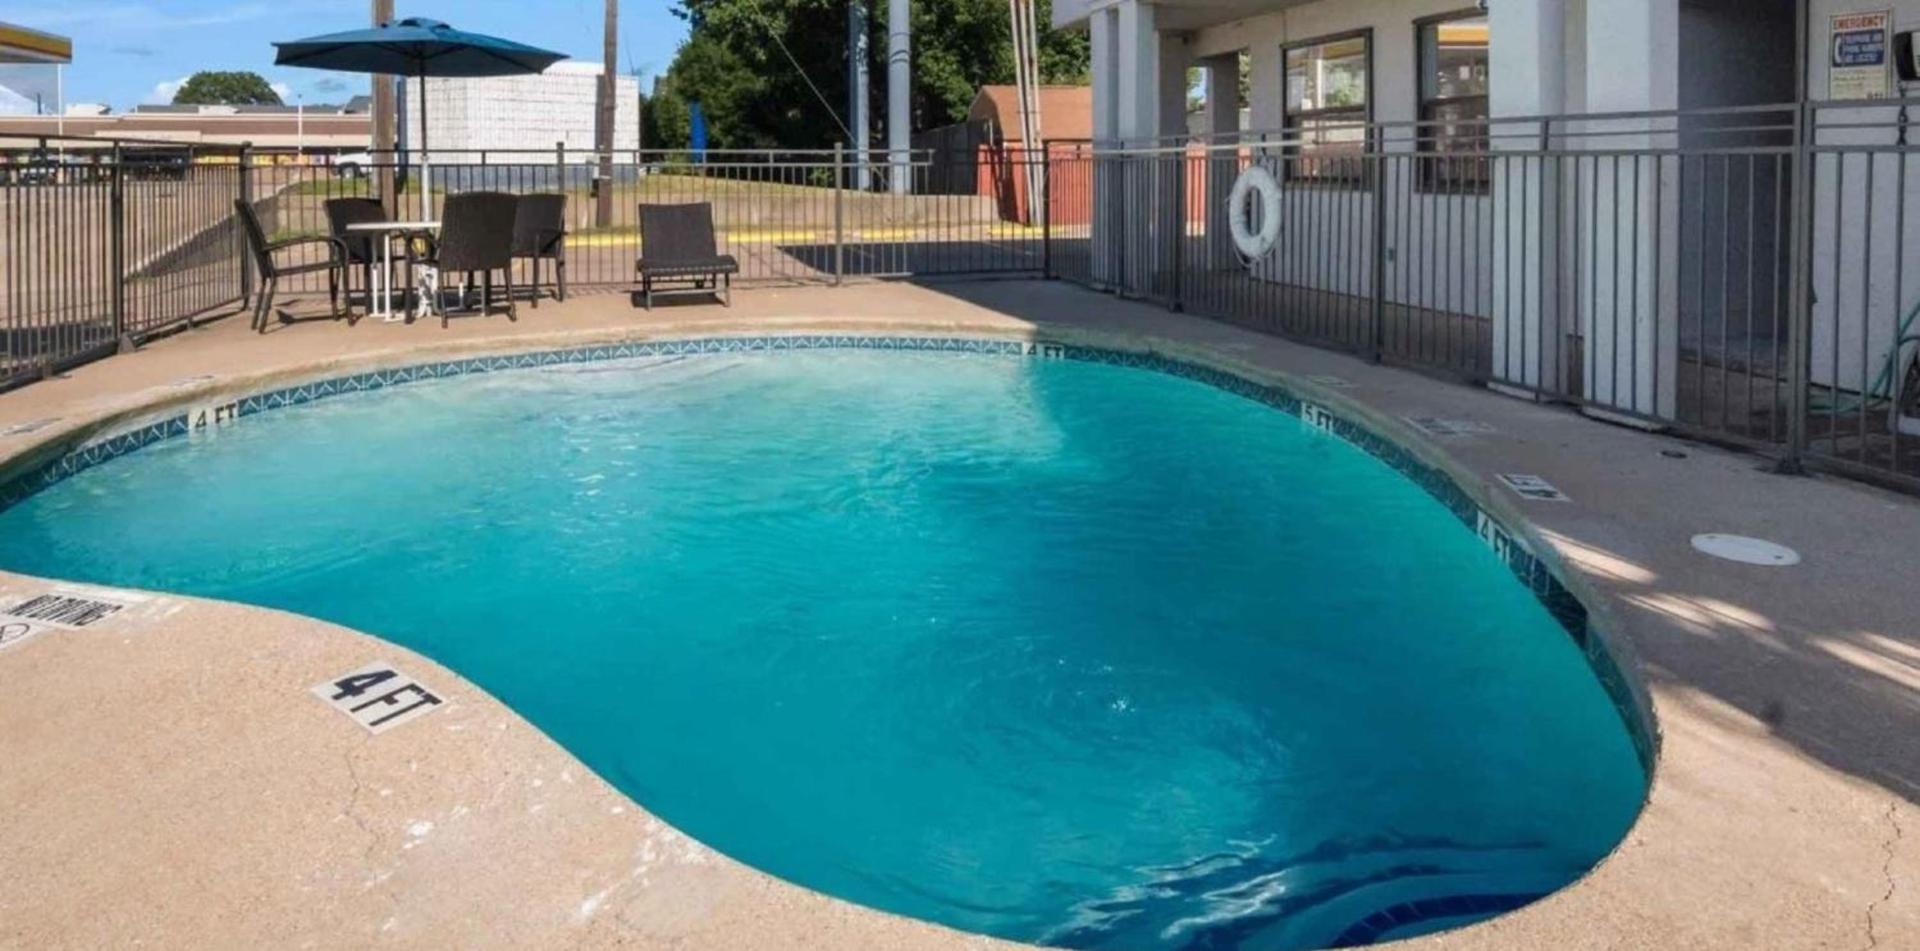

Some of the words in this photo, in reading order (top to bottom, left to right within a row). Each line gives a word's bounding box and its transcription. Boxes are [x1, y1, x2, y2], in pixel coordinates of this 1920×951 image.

[1833, 15, 1885, 30] EMERGENCY
[1044, 345, 1062, 358] FT
[195, 409, 207, 428] 4
[214, 403, 236, 424] FT
[331, 669, 398, 700] 4
[349, 683, 442, 726] FT
